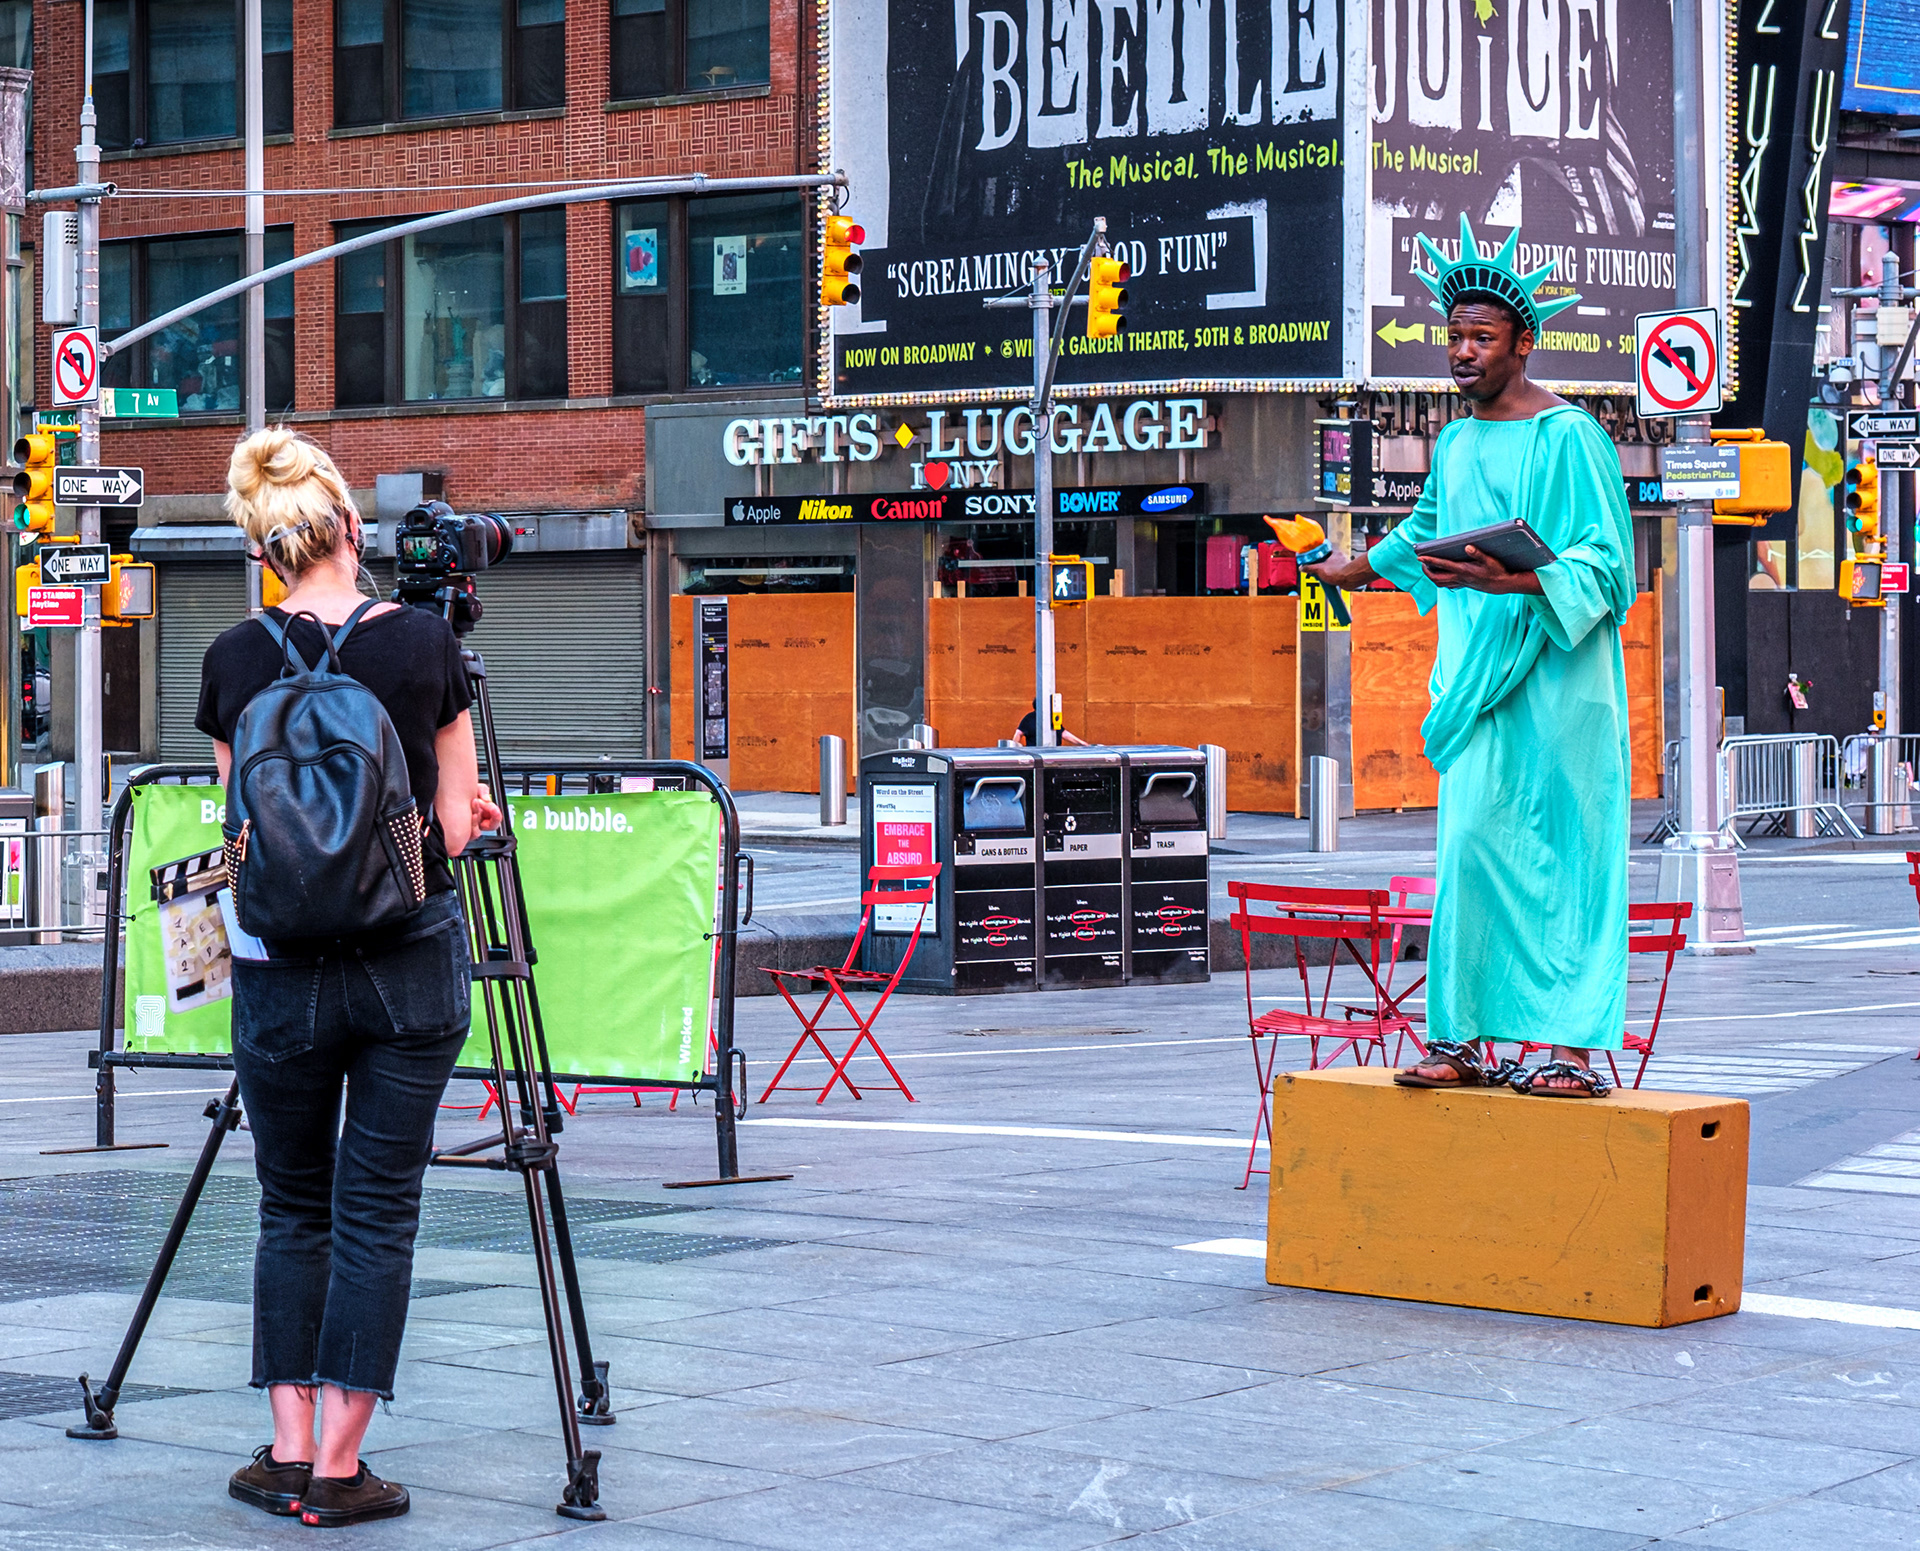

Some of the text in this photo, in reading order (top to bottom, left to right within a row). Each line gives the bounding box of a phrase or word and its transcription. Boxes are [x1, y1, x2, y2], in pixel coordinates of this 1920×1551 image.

[975, 0, 1338, 150] BEETLE
[1066, 139, 1344, 189] The Musical. The Musical.
[1371, 139, 1482, 175] The Musical.
[1585, 248, 1676, 290] FUNHOUS
[846, 348, 877, 368] NOW
[881, 346, 899, 366] ON
[904, 342, 975, 364] BROADWAY
[1070, 333, 1123, 355] GARDEN
[1128, 330, 1189, 351] THEATRE,
[1194, 327, 1229, 347] 50TH
[1234, 326, 1244, 345] &
[1249, 321, 1331, 344] BROADWAY
[132, 393, 140, 413] 7
[722, 399, 1206, 466] GIFTS LUGGAGE
[1859, 419, 1911, 431] ONE WAY
[1882, 450, 1916, 460] ONE WAY
[1666, 459, 1727, 471] Times Square
[951, 459, 1000, 489] NY
[1666, 470, 1736, 480] Pedestrian Plaza
[62, 478, 130, 494] ONE WAY
[1388, 481, 1421, 500] Apple
[747, 491, 1188, 523] Apple Nikon Canon SONY BOWER SAMSUNG
[52, 557, 100, 573] ONE WAY
[31, 591, 76, 600] NO STANDING
[31, 600, 60, 610] Anytime
[522, 810, 537, 829] a
[544, 806, 633, 833] bubble.
[884, 824, 925, 836] EMBRACE
[898, 839, 910, 848] THE
[1070, 844, 1088, 852] PAPER
[1156, 840, 1176, 848] TRASH
[886, 852, 922, 864] ABSURD
[679, 1007, 694, 1065] Wicked
